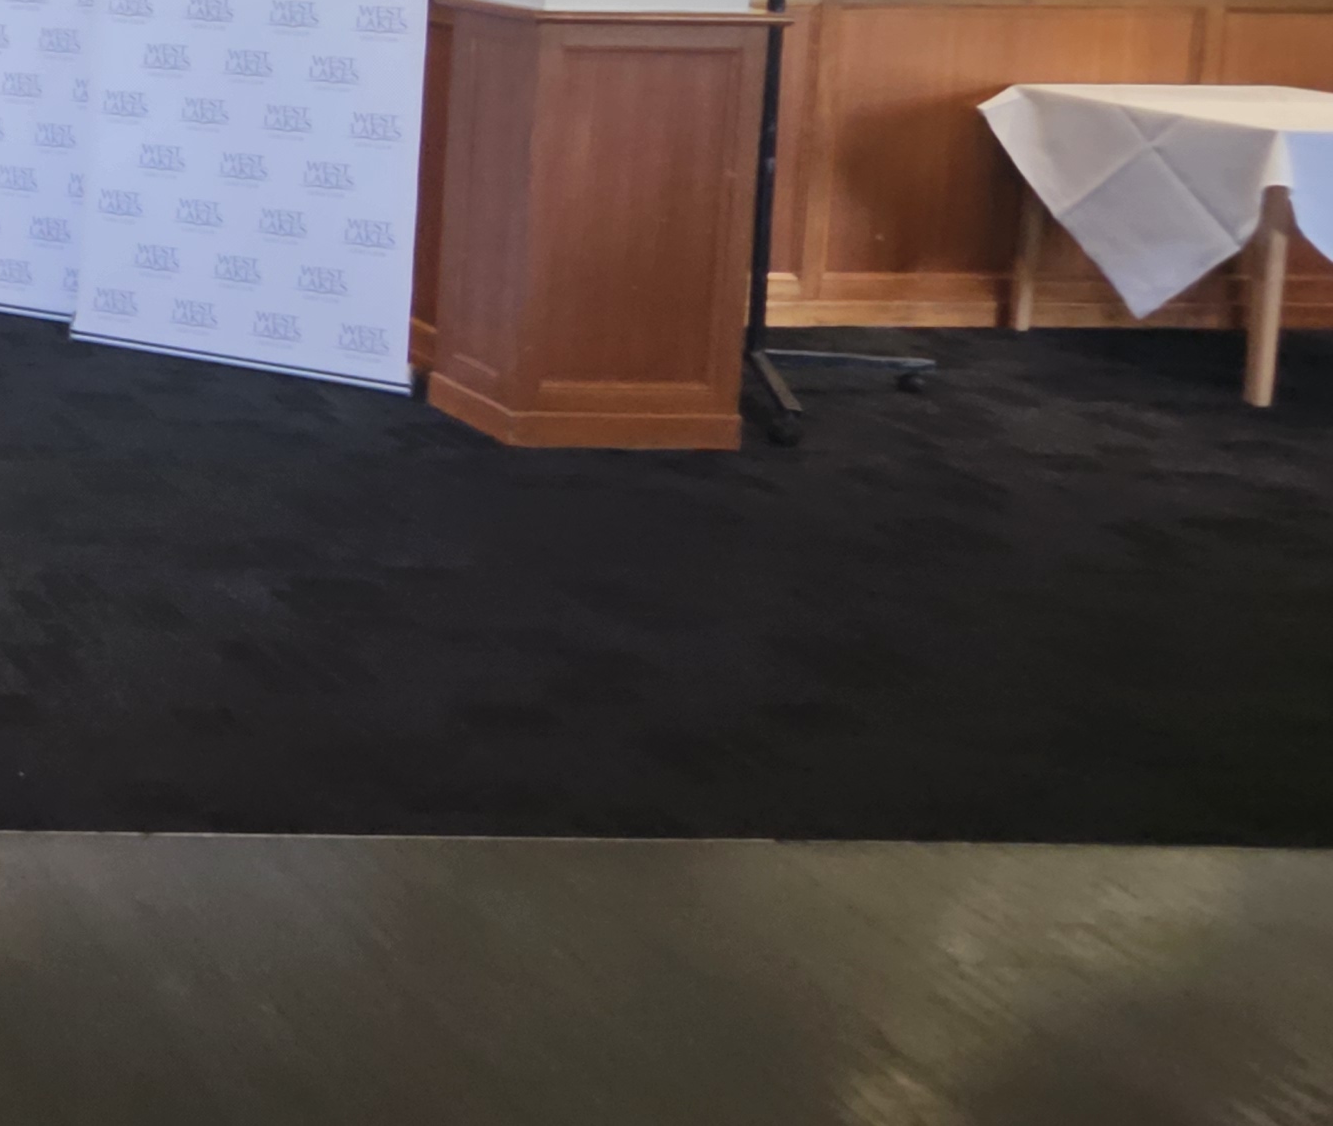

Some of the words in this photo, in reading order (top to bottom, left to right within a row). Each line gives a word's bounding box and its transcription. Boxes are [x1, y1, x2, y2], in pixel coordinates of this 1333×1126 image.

[107, 0, 153, 14] LAKES
[186, 5, 234, 19] LAKES
[271, 0, 316, 12] WEST
[358, 4, 405, 18] WEST
[269, 10, 319, 25] LAKES
[355, 15, 407, 31] LAKES
[146, 42, 188, 55] WEST
[227, 48, 270, 62] WEST
[144, 53, 190, 68] LAKES
[224, 59, 273, 74] LAKES
[311, 54, 357, 68] WEST
[309, 66, 359, 81] LAKES
[104, 89, 145, 102] WEST
[183, 96, 226, 110] WEST
[102, 99, 148, 115] LAKES
[181, 106, 229, 122] LAKES
[265, 103, 310, 117] WEST
[263, 114, 313, 130] LAKES
[352, 111, 398, 126] WEST
[350, 122, 401, 139] LAKES
[141, 142, 183, 156] WEST
[139, 153, 185, 169] LAKES
[221, 150, 265, 165] WEST
[219, 162, 267, 178] LAKES
[305, 159, 351, 174] WEST
[303, 170, 354, 187] LAKES
[100, 187, 140, 202] WEST
[97, 198, 143, 214] LAKES
[178, 197, 220, 212] WEST
[176, 208, 223, 224] LAKES
[260, 207, 305, 222] WEST
[258, 218, 307, 235] LAKES
[346, 217, 392, 233] WEST
[344, 228, 395, 246] LAKES
[136, 242, 178, 257] WEST
[134, 253, 180, 270] LAKES
[216, 253, 259, 269] WEST
[214, 264, 262, 281] LAKES
[300, 264, 345, 280] WEST
[297, 275, 348, 293] LAKES
[95, 285, 136, 301] WEST
[93, 296, 138, 314] LAKES
[173, 297, 215, 313] WEST
[171, 308, 218, 326] LAKES
[255, 309, 299, 326] WEST
[252, 320, 302, 339] LAKES
[340, 322, 386, 339] WEST
[338, 333, 389, 352] LAKES
